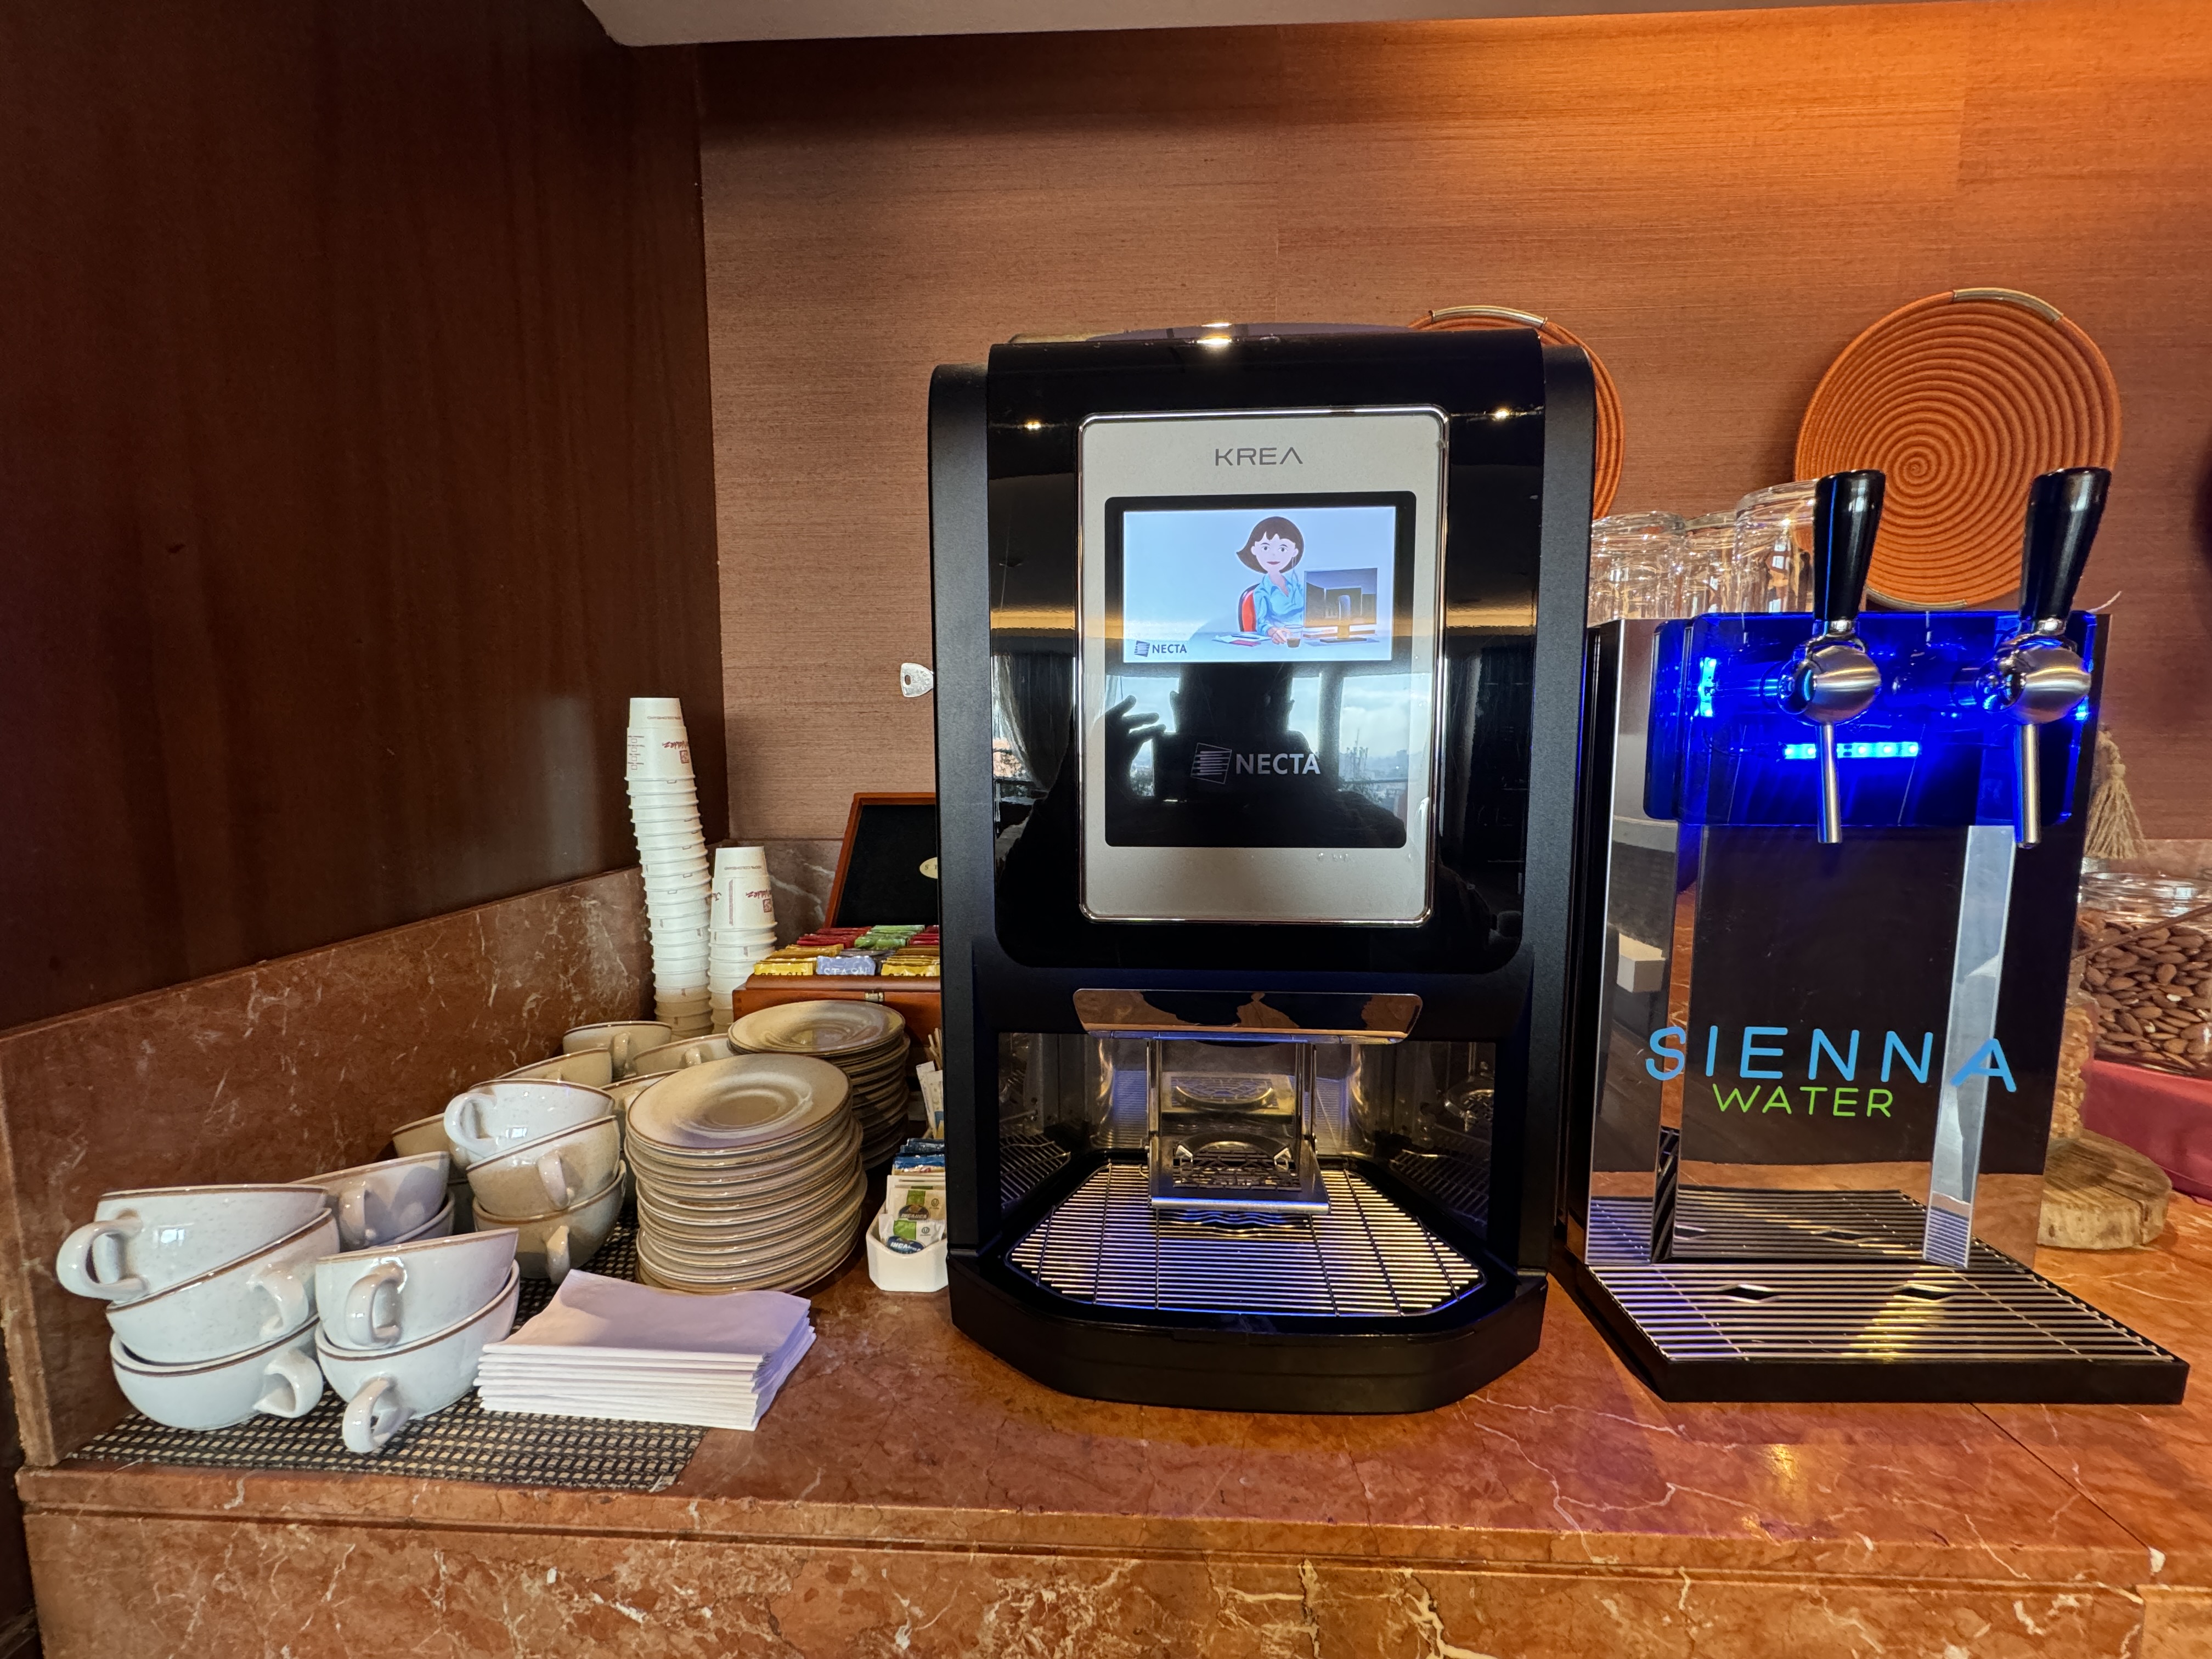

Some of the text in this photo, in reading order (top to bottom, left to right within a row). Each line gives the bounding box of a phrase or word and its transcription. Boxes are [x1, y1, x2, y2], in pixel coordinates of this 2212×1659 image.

[1215, 447, 1303, 466] KREA
[1152, 644, 1187, 654] NECTA
[1236, 753, 1321, 775] NECTA
[1645, 1025, 2017, 1092] SIENNA
[1712, 1083, 1893, 1118] WATER
